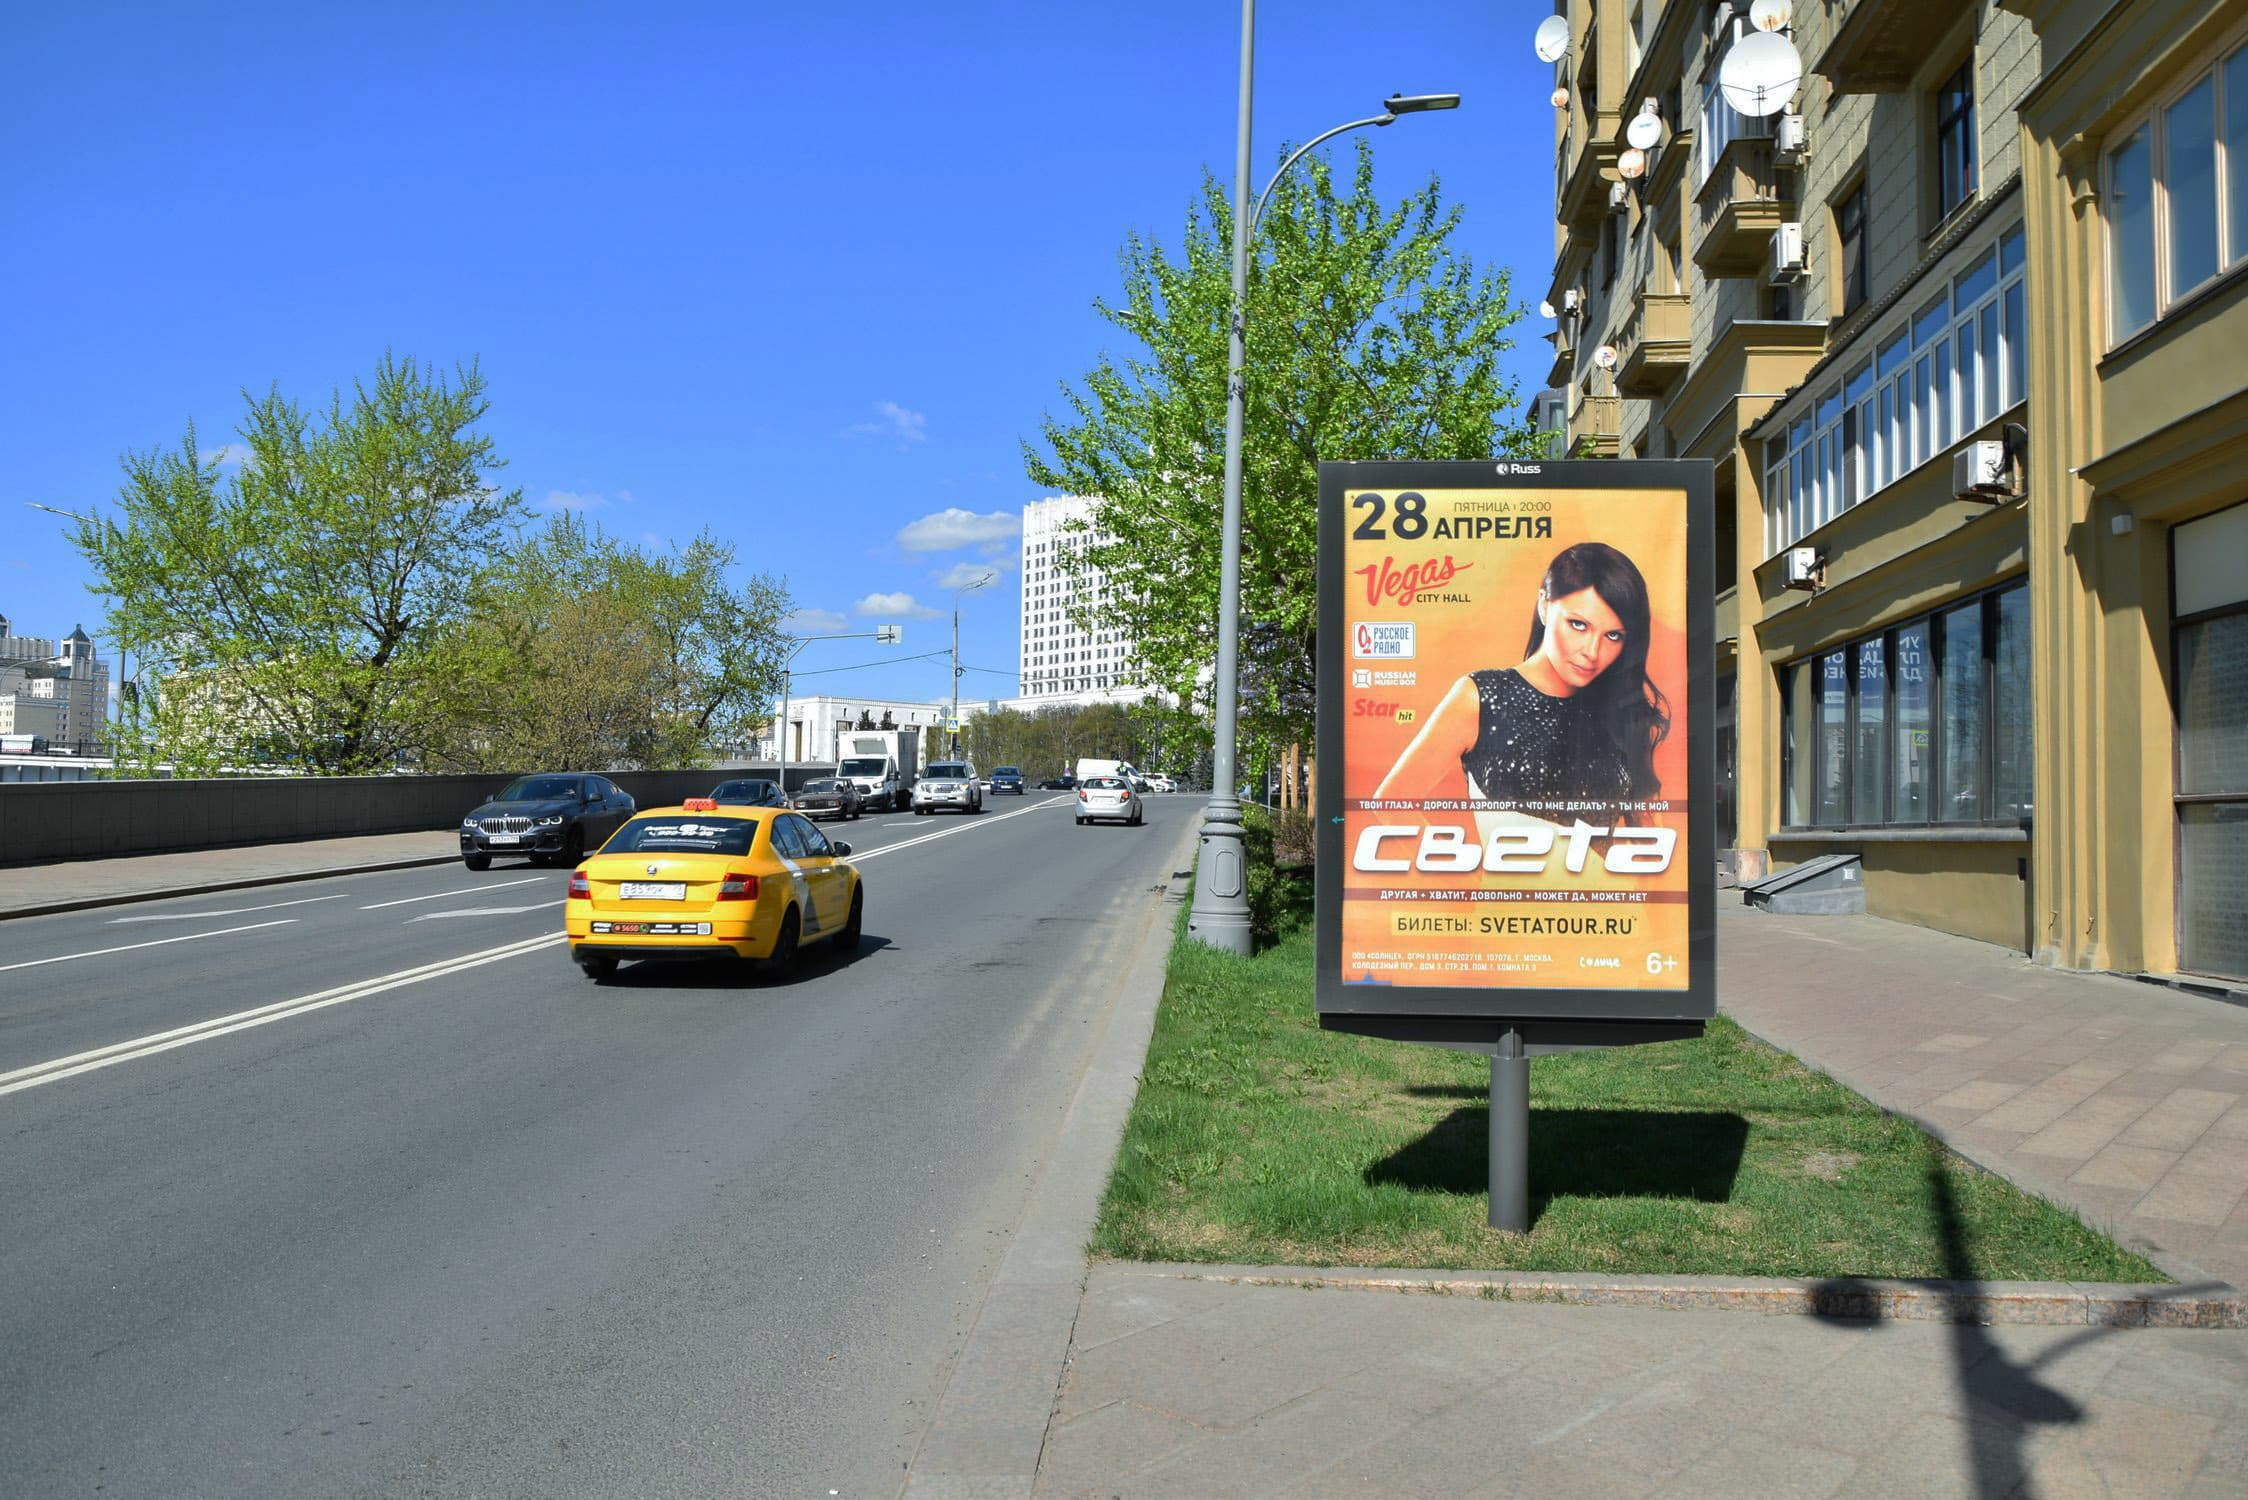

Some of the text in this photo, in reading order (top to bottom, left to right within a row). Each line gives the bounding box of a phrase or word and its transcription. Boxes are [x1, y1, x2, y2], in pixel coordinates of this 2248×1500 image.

[1511, 464, 1541, 474] Russ
[1454, 502, 1551, 513] ПЯТНИЦА 20:00
[1352, 492, 1552, 540] 28 АПРЕЛЯ
[1354, 555, 1474, 606] Vegas
[1416, 594, 1471, 602] CITY HALL
[1374, 627, 1409, 640] РУССКОЕ
[1374, 641, 1400, 654] РАДИО
[1353, 698, 1412, 720] Star hit
[1360, 801, 1669, 811] ТВОИ ГЛАЗА ДОРОГА В АЭРОПОРТ ЧТО МНЕ ДЕЛАТЬ? ТЫ НЕ МОЙ
[1380, 890, 1648, 902] ДРУГАЯ ХВАТИТ, ДОВОЛЬНО МОЖЕТ ДА, МОЖЕТ НЕТ
[1397, 917, 1633, 934] БИЛЕТЫ: SVETATOUR.RU
[1647, 952, 1678, 974] 6+
